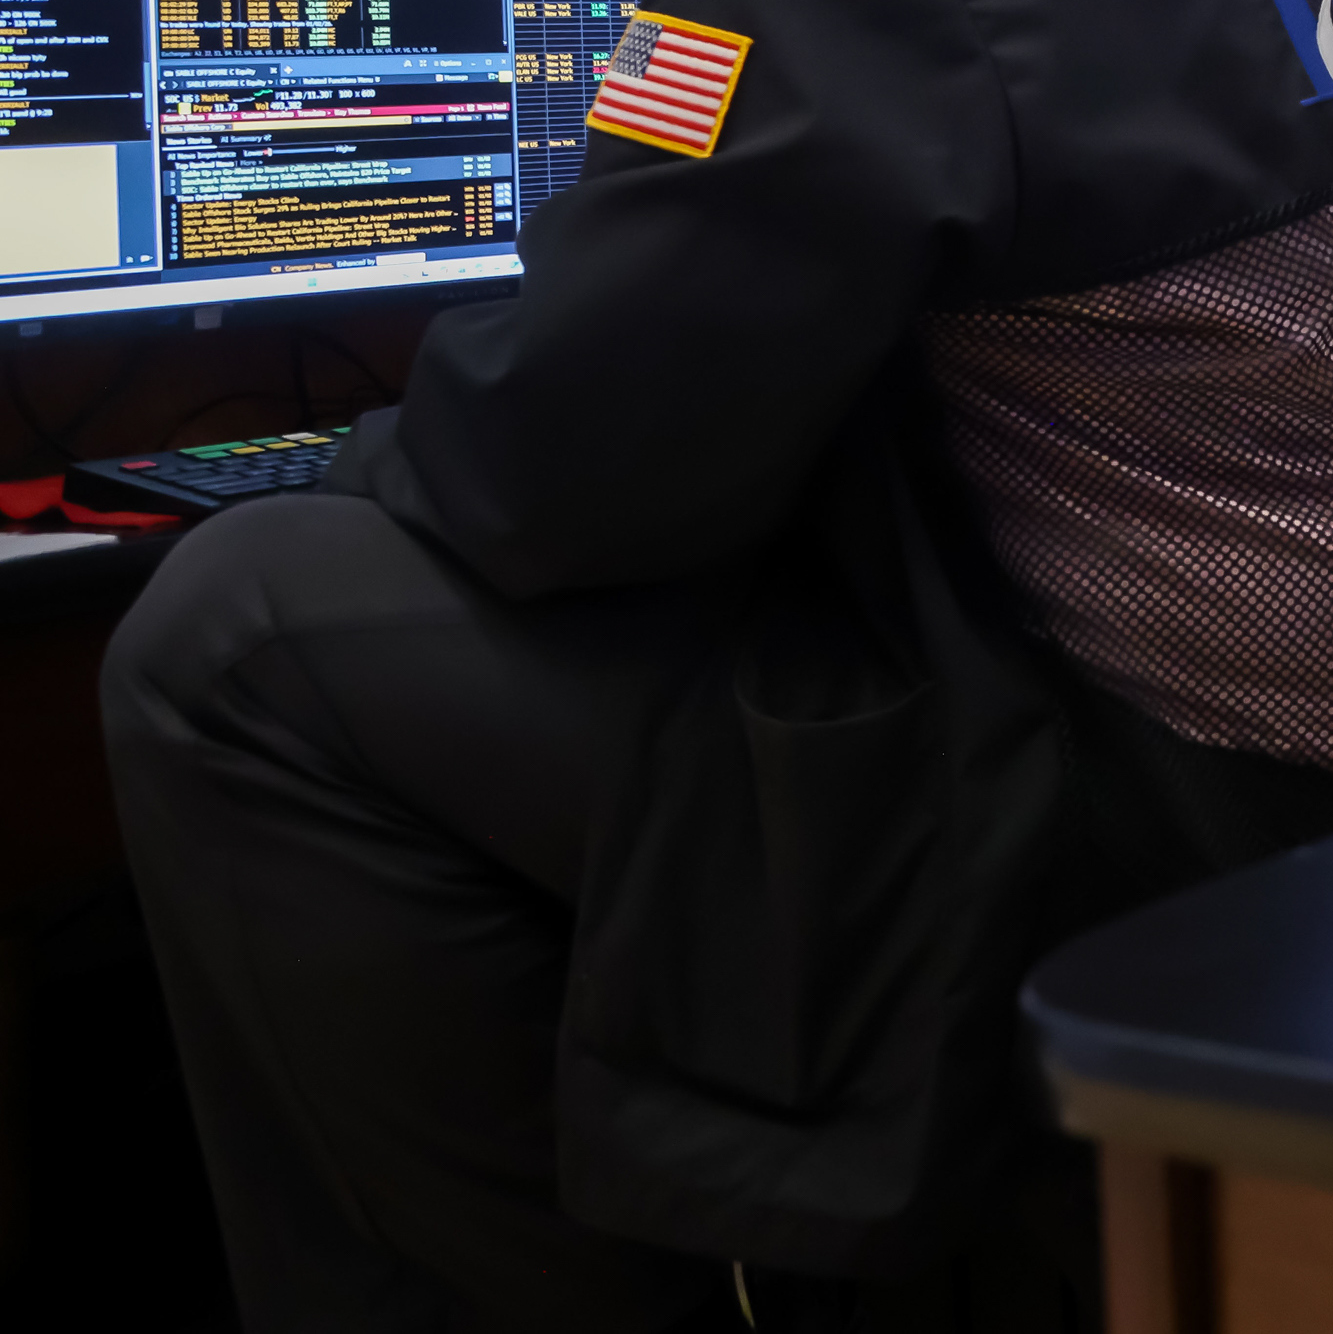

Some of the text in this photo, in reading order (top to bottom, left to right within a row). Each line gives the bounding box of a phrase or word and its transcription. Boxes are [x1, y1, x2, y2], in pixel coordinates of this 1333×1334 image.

[236, 68, 256, 76] Equity
[246, 79, 266, 87] Equity
[338, 89, 353, 98] 100
[361, 89, 376, 98] 600
[164, 94, 180, 103] SOC
[182, 94, 193, 103] US
[200, 94, 230, 103] Market
[193, 103, 239, 113] Prev 11.73
[254, 102, 269, 111] Vol
[230, 135, 262, 143] Summary
[367, 258, 376, 266] by
